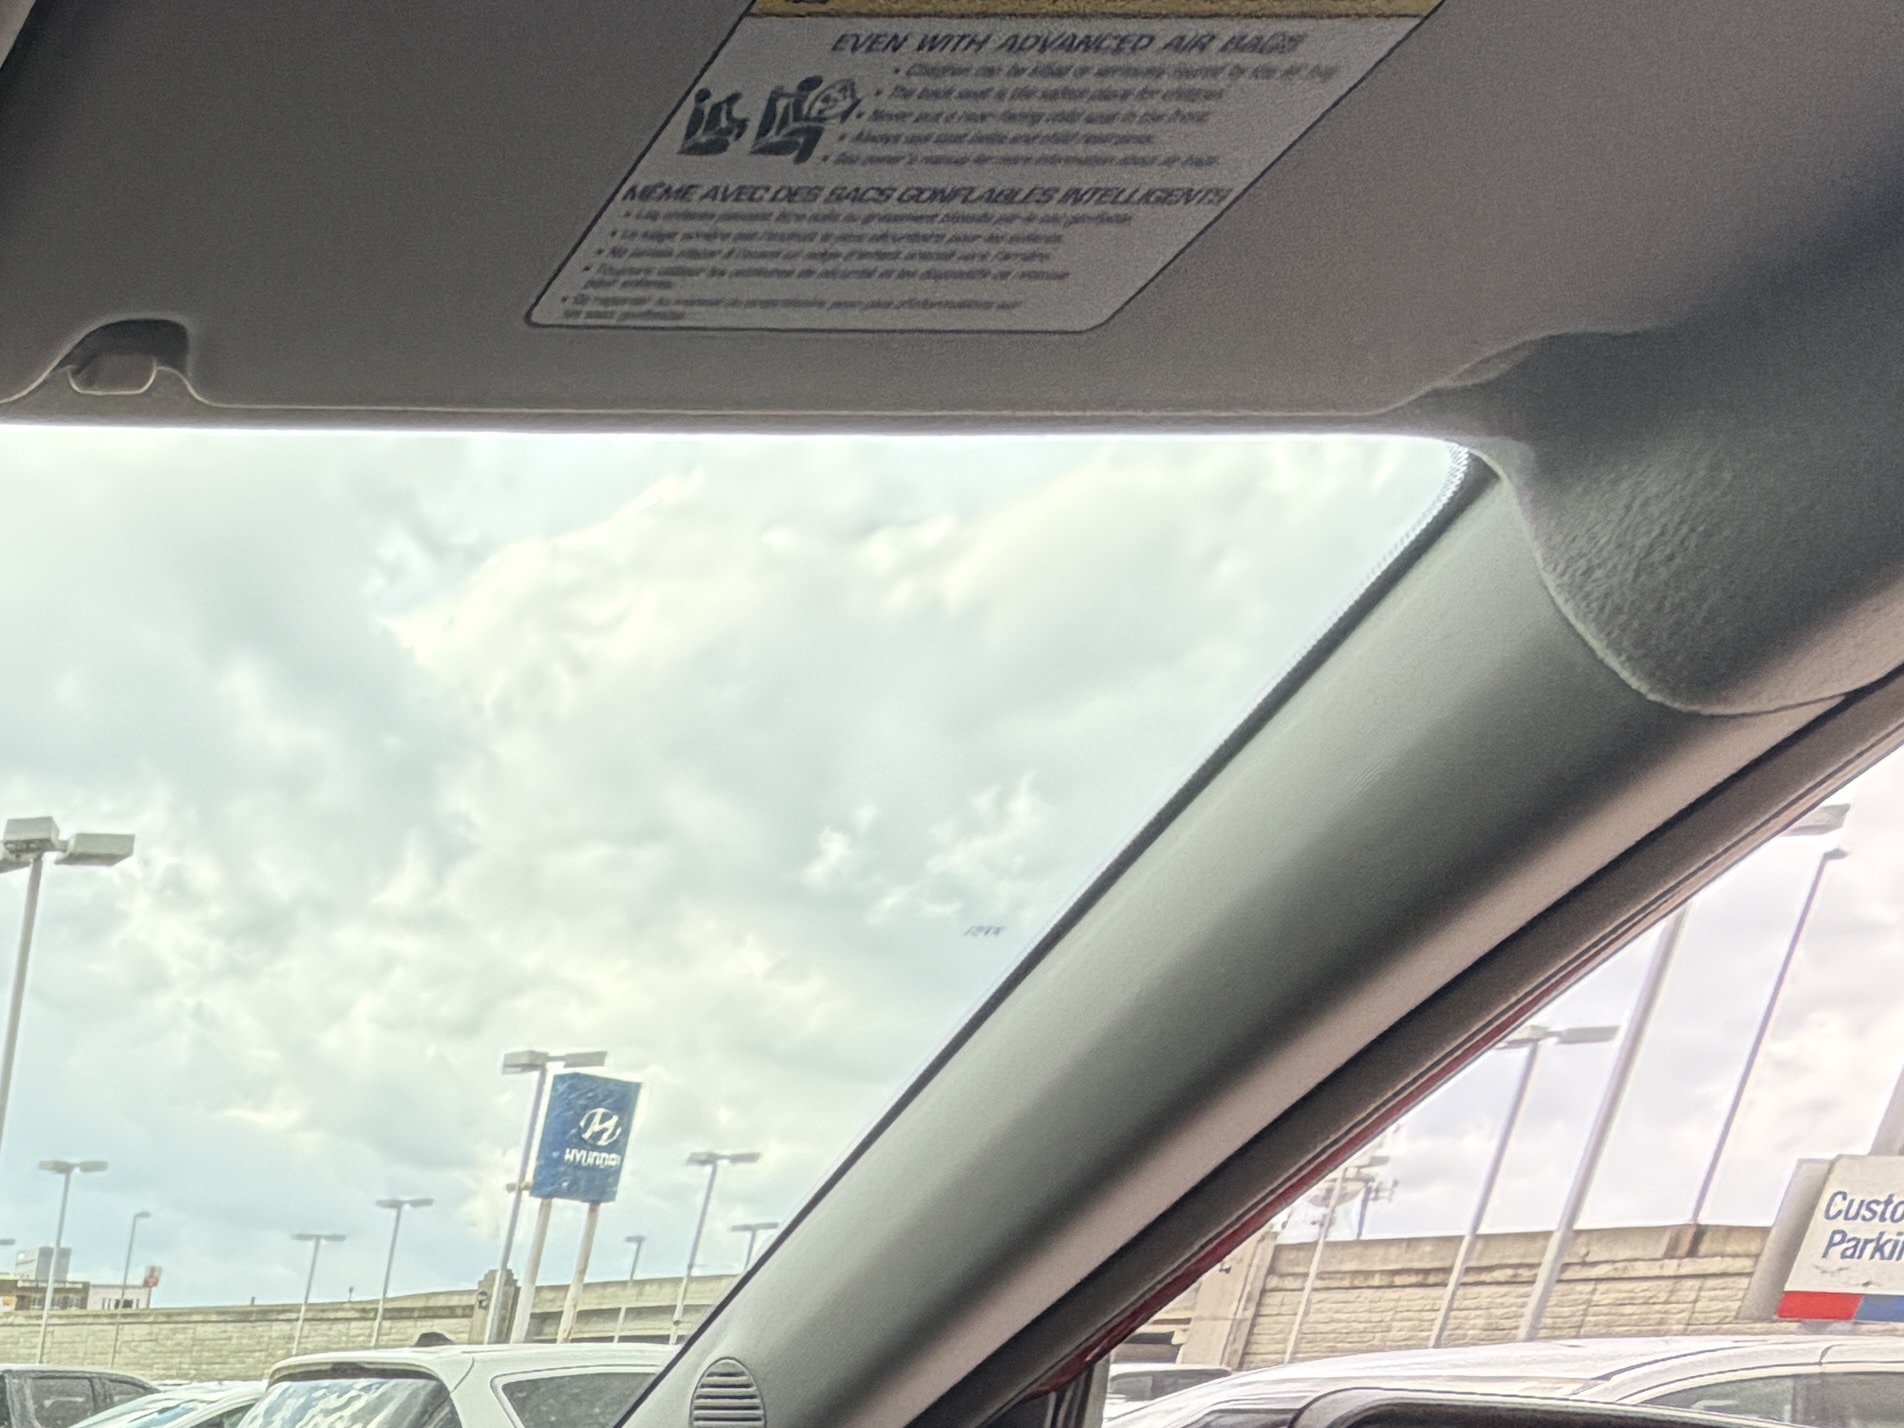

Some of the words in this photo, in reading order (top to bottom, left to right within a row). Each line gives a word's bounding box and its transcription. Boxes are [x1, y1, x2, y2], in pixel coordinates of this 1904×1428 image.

[831, 32, 911, 54] EVEN
[914, 32, 991, 53] WITH
[996, 31, 1156, 55] ADVANCED
[1165, 32, 1219, 55] AIR
[1219, 32, 1309, 56] BAGS
[621, 182, 699, 206] MÊME
[700, 185, 767, 205] AVEC
[767, 185, 822, 205] DES
[828, 185, 893, 206] SACS
[895, 185, 1056, 207] GONFLABLES
[1059, 186, 1233, 208] INTELLIGENTS
